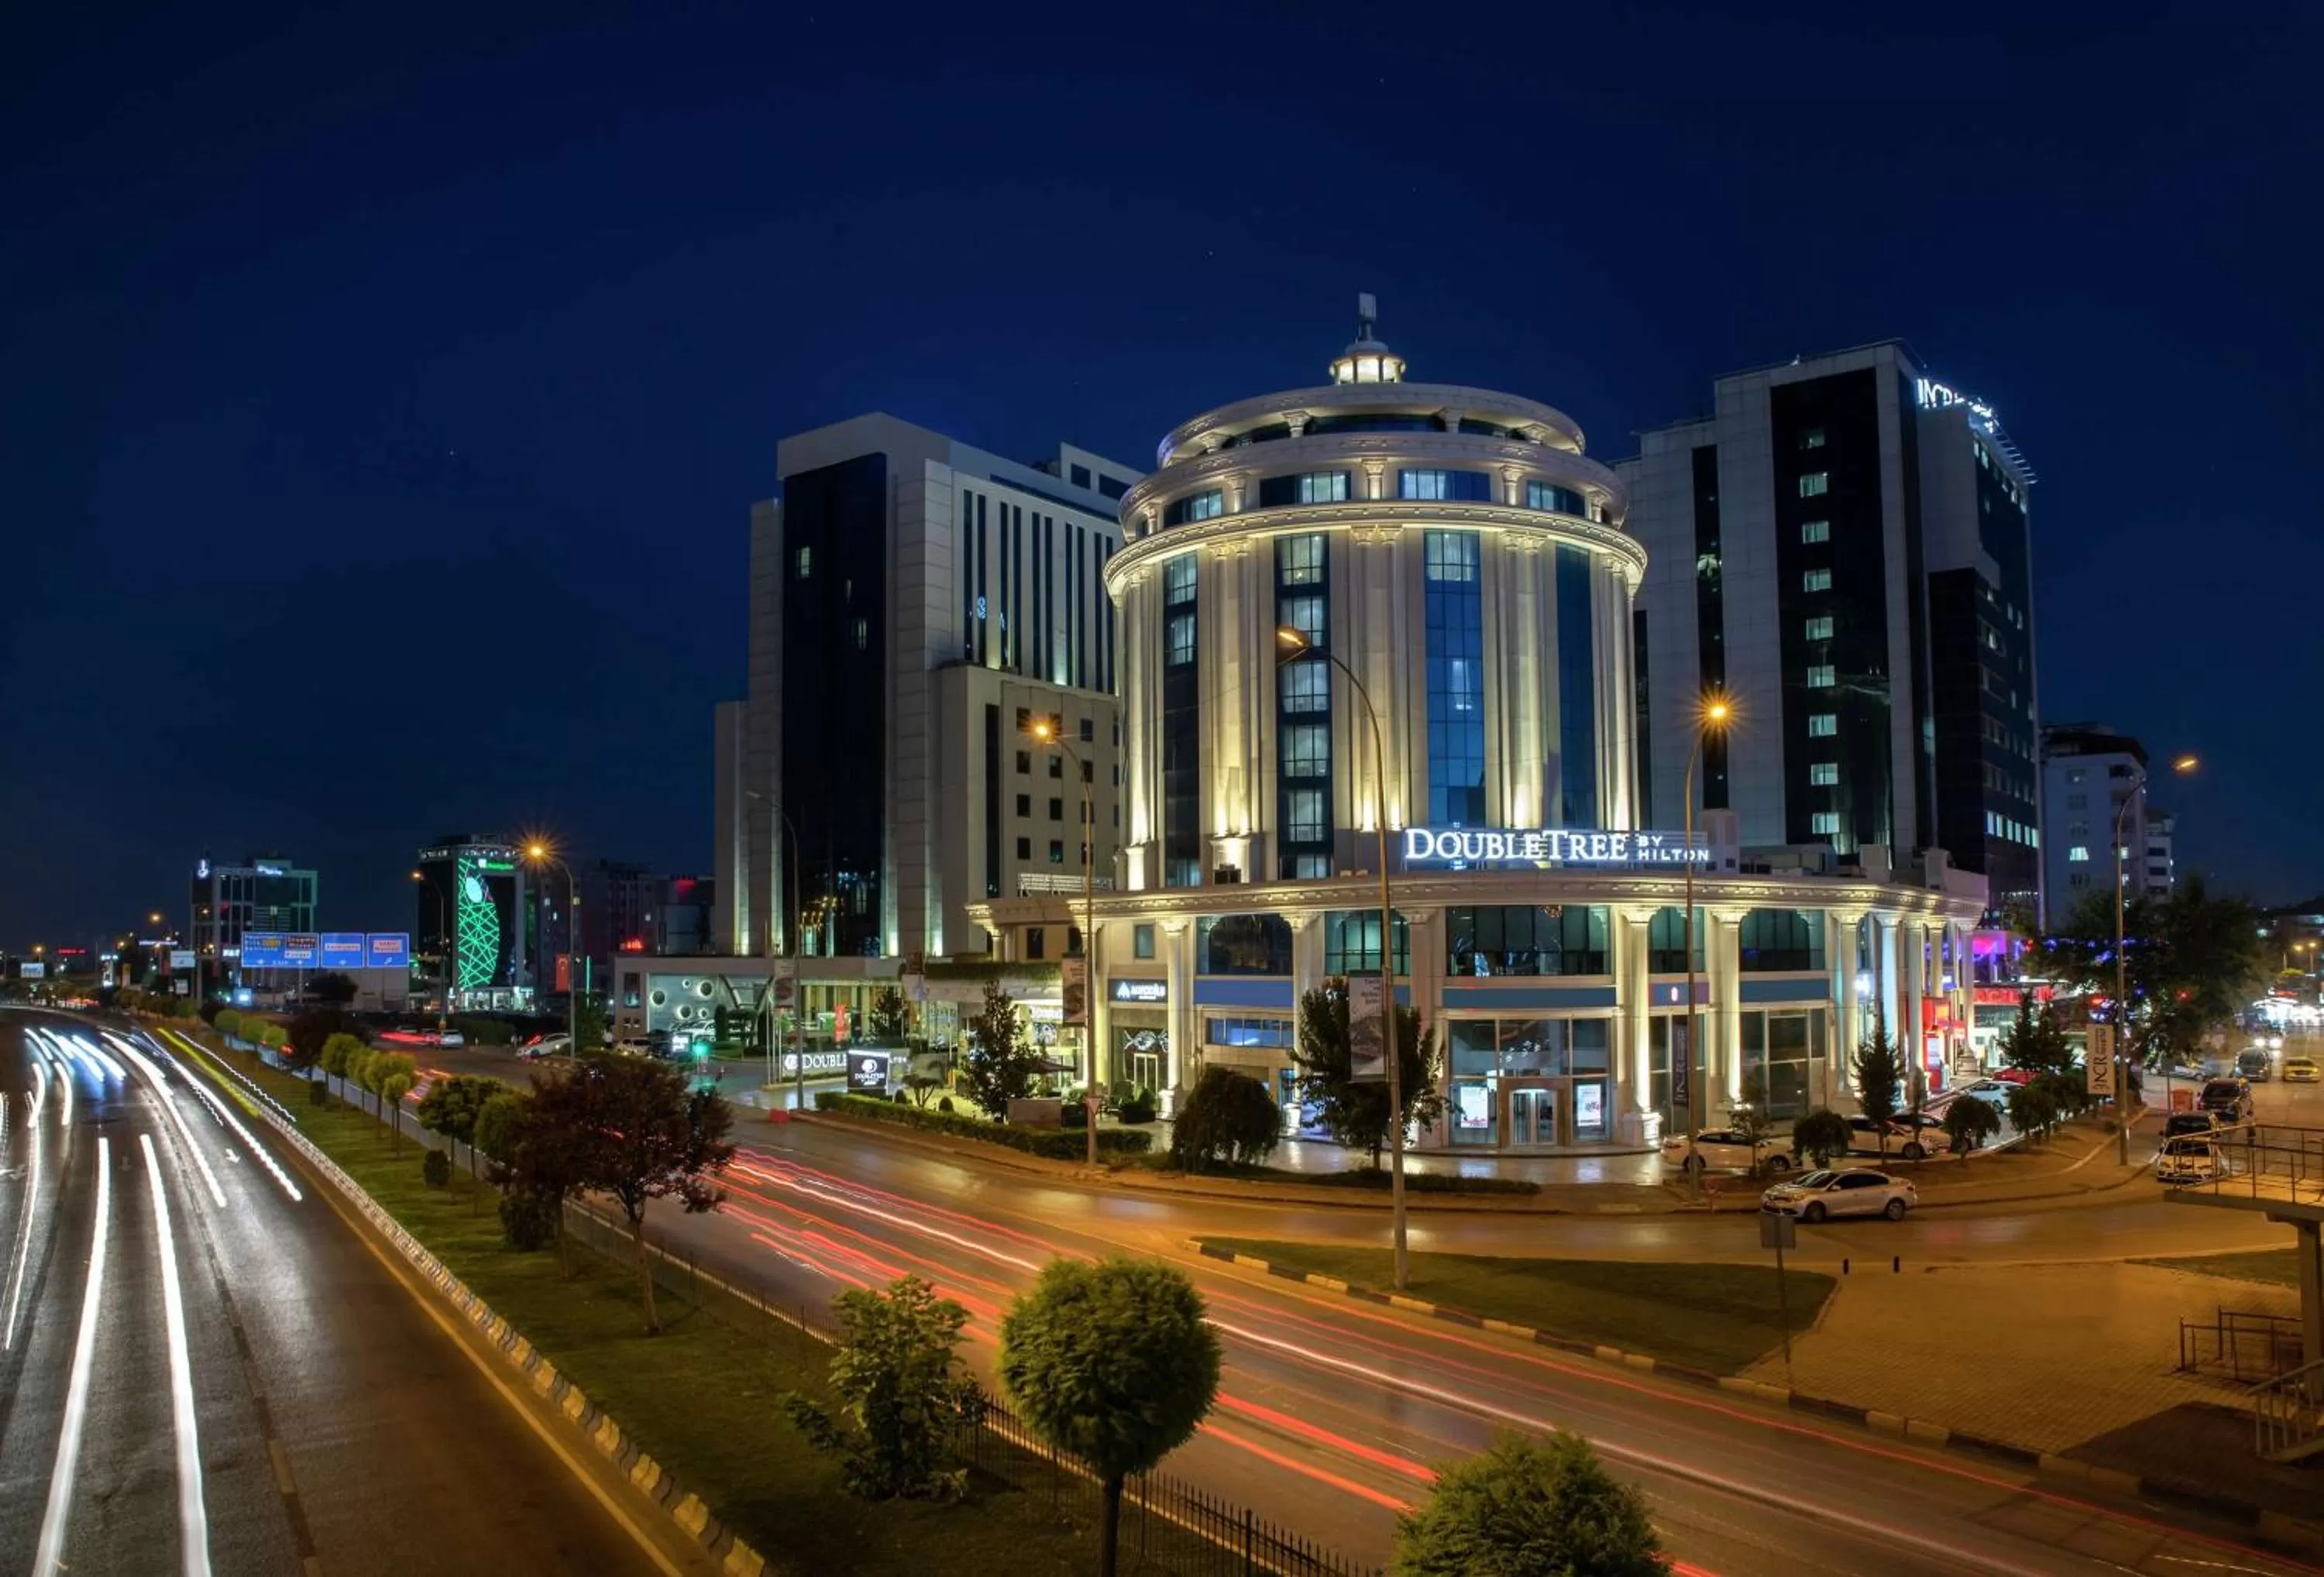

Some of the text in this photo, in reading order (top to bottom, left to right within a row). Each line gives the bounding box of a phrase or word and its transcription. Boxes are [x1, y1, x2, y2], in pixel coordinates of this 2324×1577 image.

[1405, 828, 1663, 861] DOUBLETREE BY
[1638, 848, 1710, 861] HILTON
